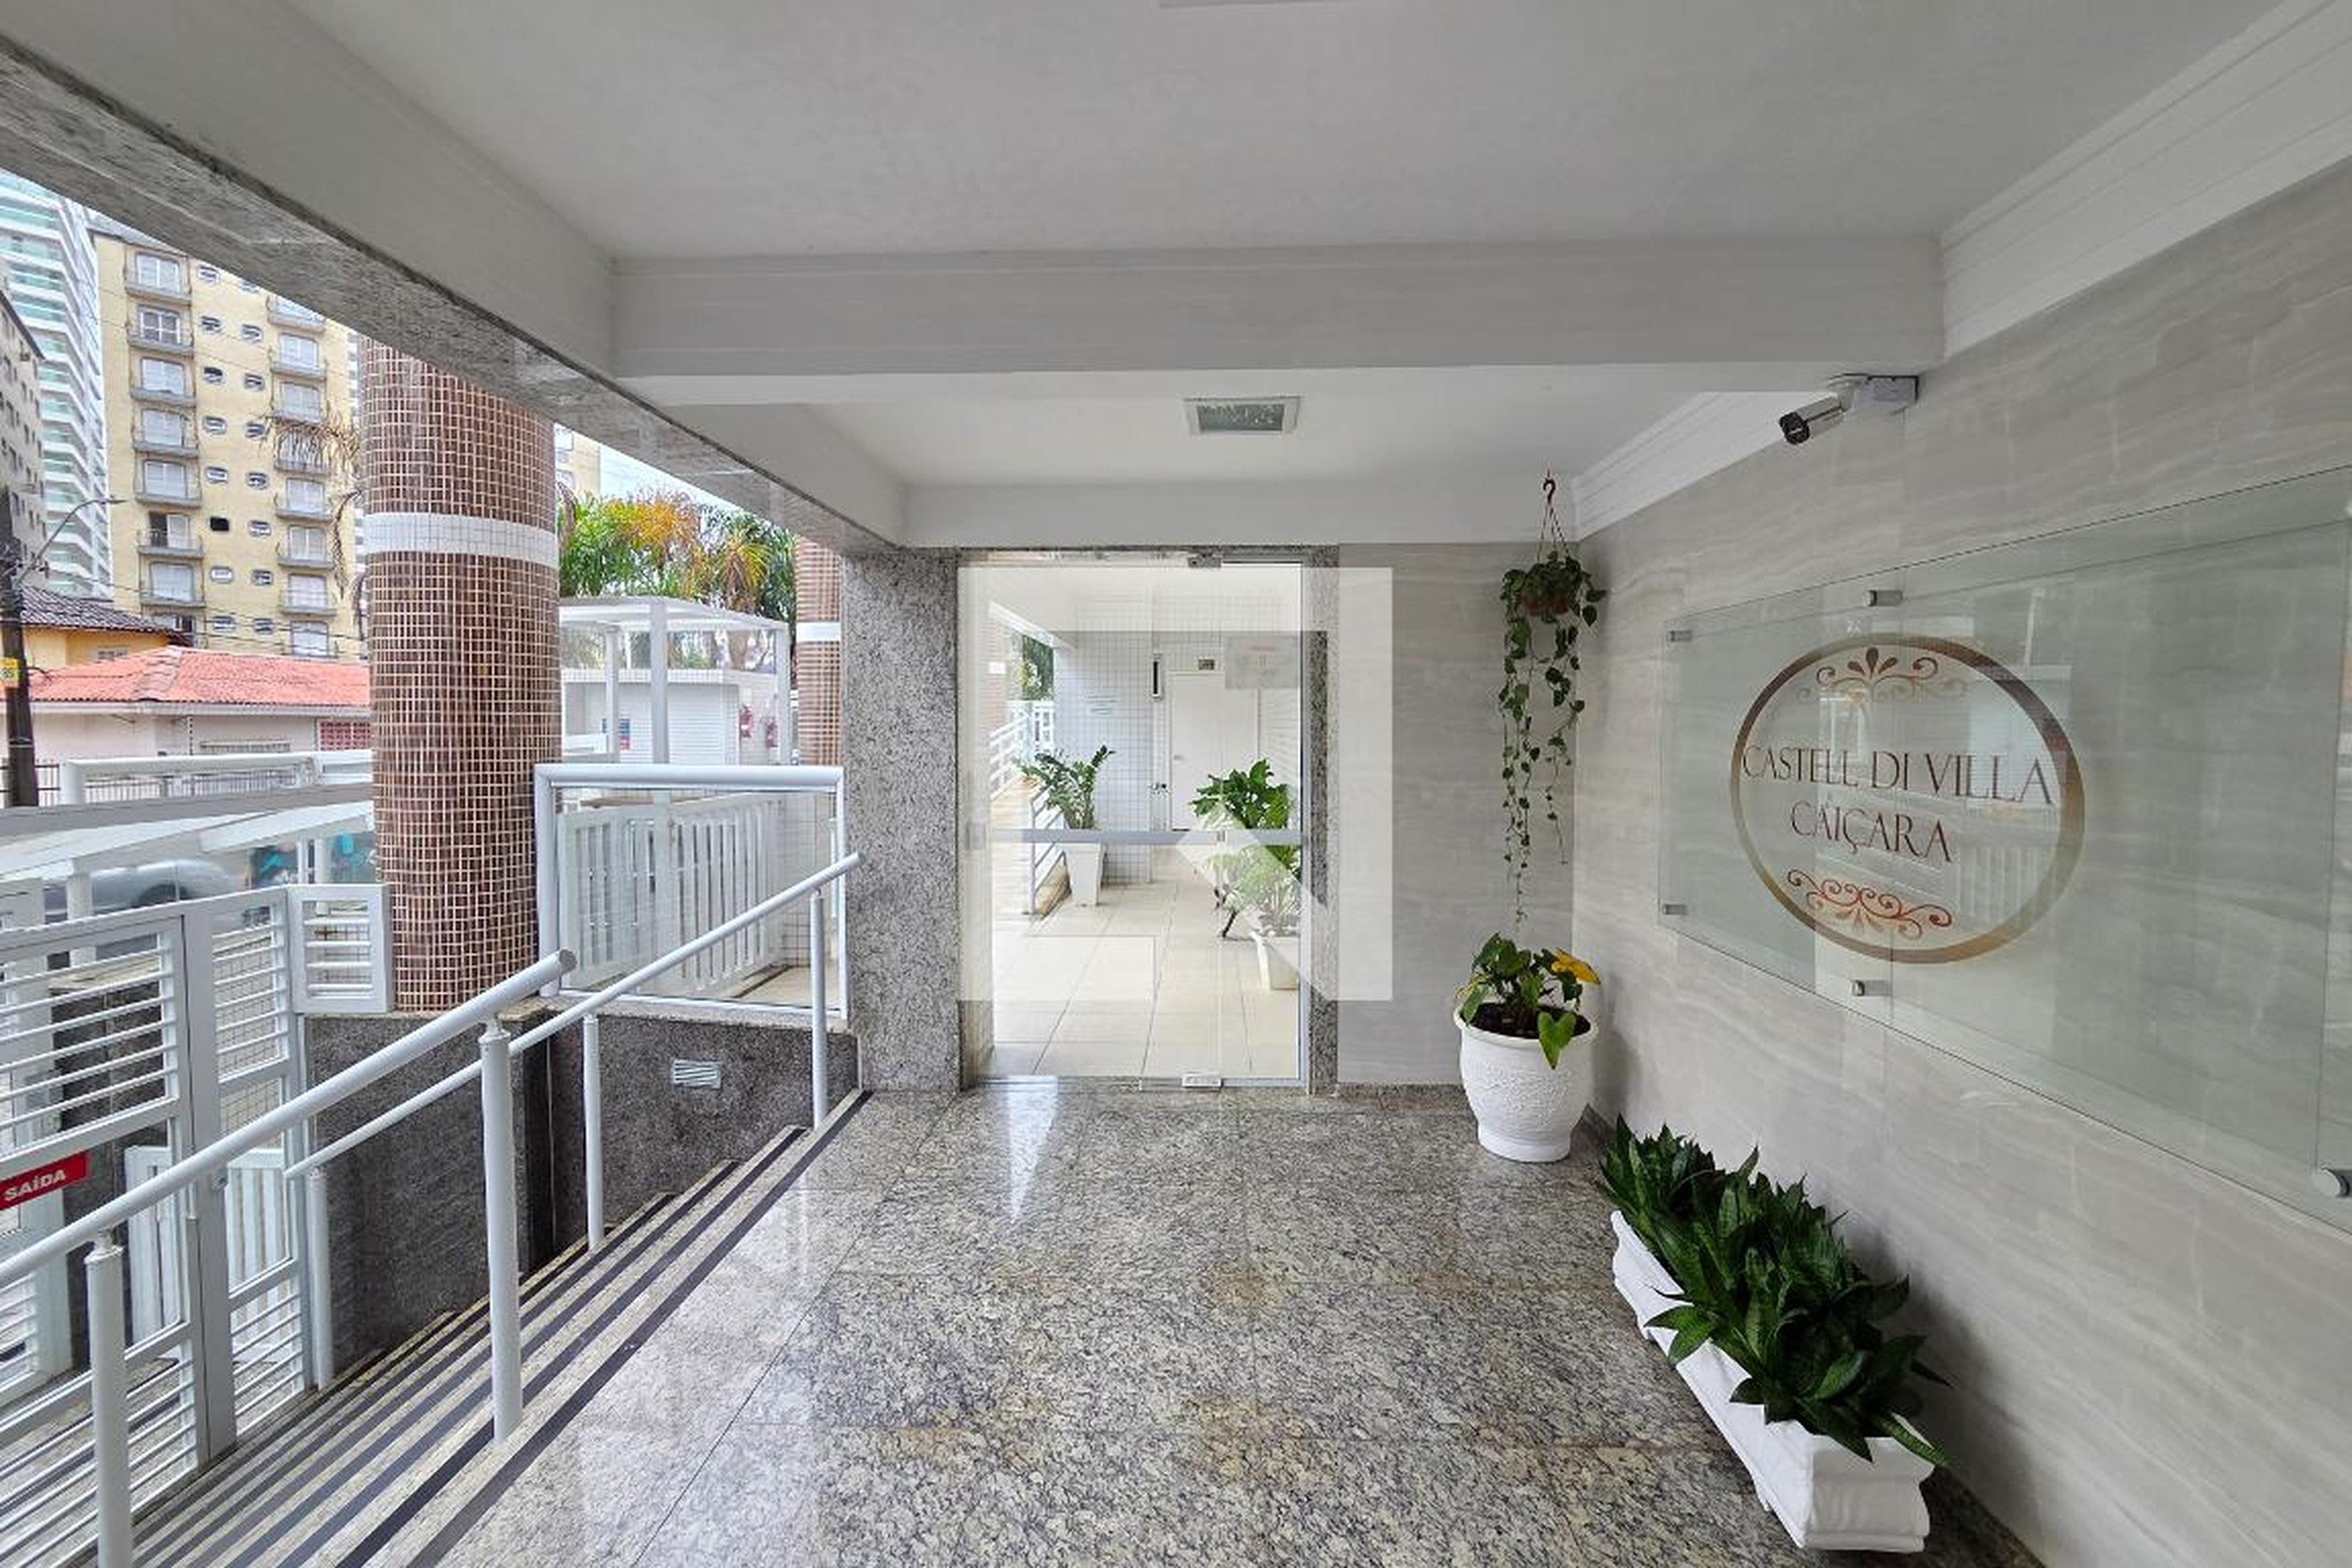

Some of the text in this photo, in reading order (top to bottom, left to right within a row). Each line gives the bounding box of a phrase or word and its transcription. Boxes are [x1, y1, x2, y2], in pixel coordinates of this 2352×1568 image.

[1743, 745, 2054, 805] CASTELL DI VILLA
[1790, 800, 1952, 863] CAIÇARA
[4, 1169, 66, 1201] SAÍDA
